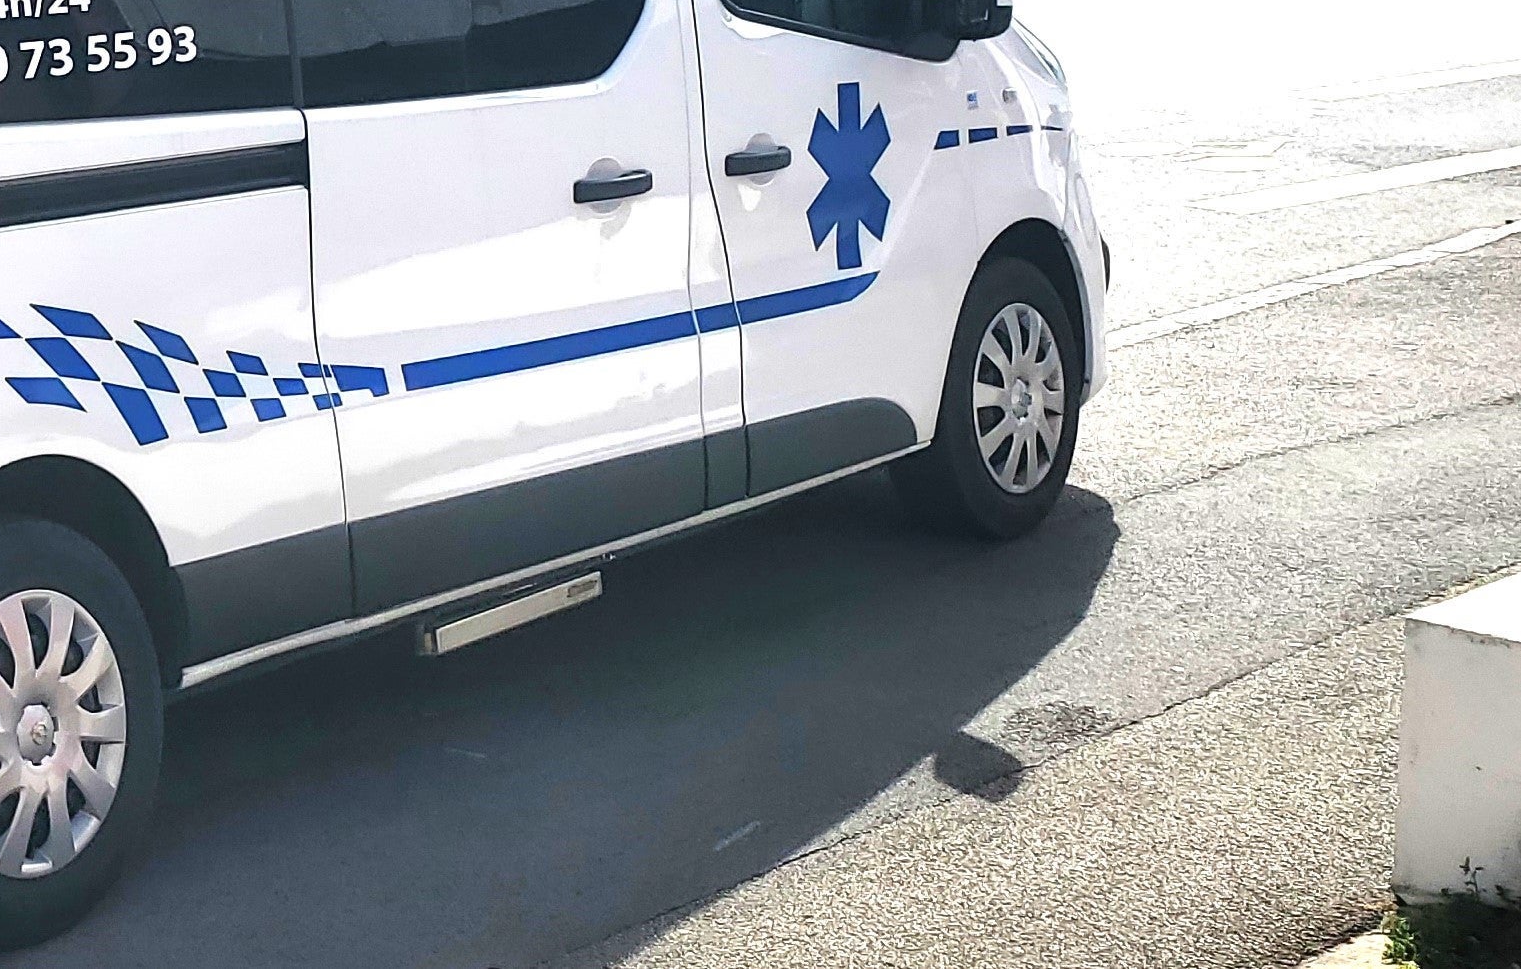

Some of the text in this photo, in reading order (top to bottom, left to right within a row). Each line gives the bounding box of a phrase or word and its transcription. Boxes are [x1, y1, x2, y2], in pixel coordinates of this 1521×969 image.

[19, 37, 74, 79] 73
[87, 31, 137, 73] 55
[147, 25, 198, 65] 93
